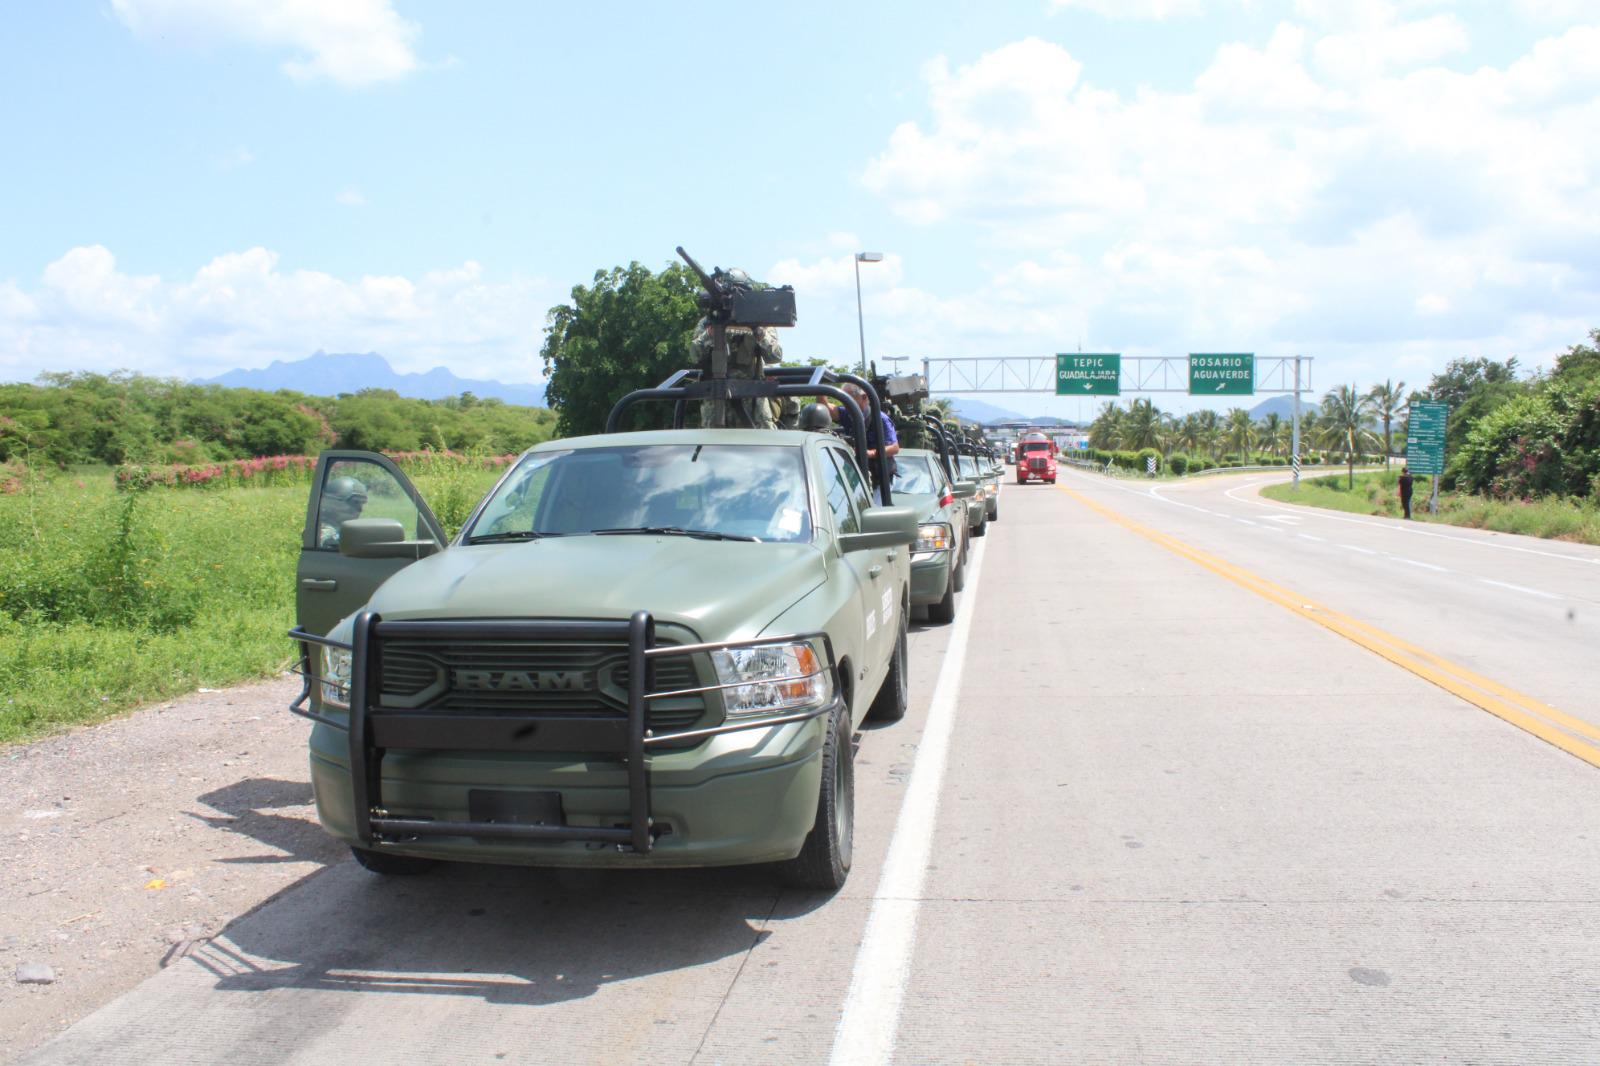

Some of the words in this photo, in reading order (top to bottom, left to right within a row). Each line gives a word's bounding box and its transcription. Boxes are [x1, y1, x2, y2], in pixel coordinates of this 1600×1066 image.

[1073, 358, 1103, 367] TEPIC
[1191, 358, 1242, 367] ROSARIO
[1059, 370, 1116, 380] GUADALAJARA
[455, 670, 586, 691] RAM
